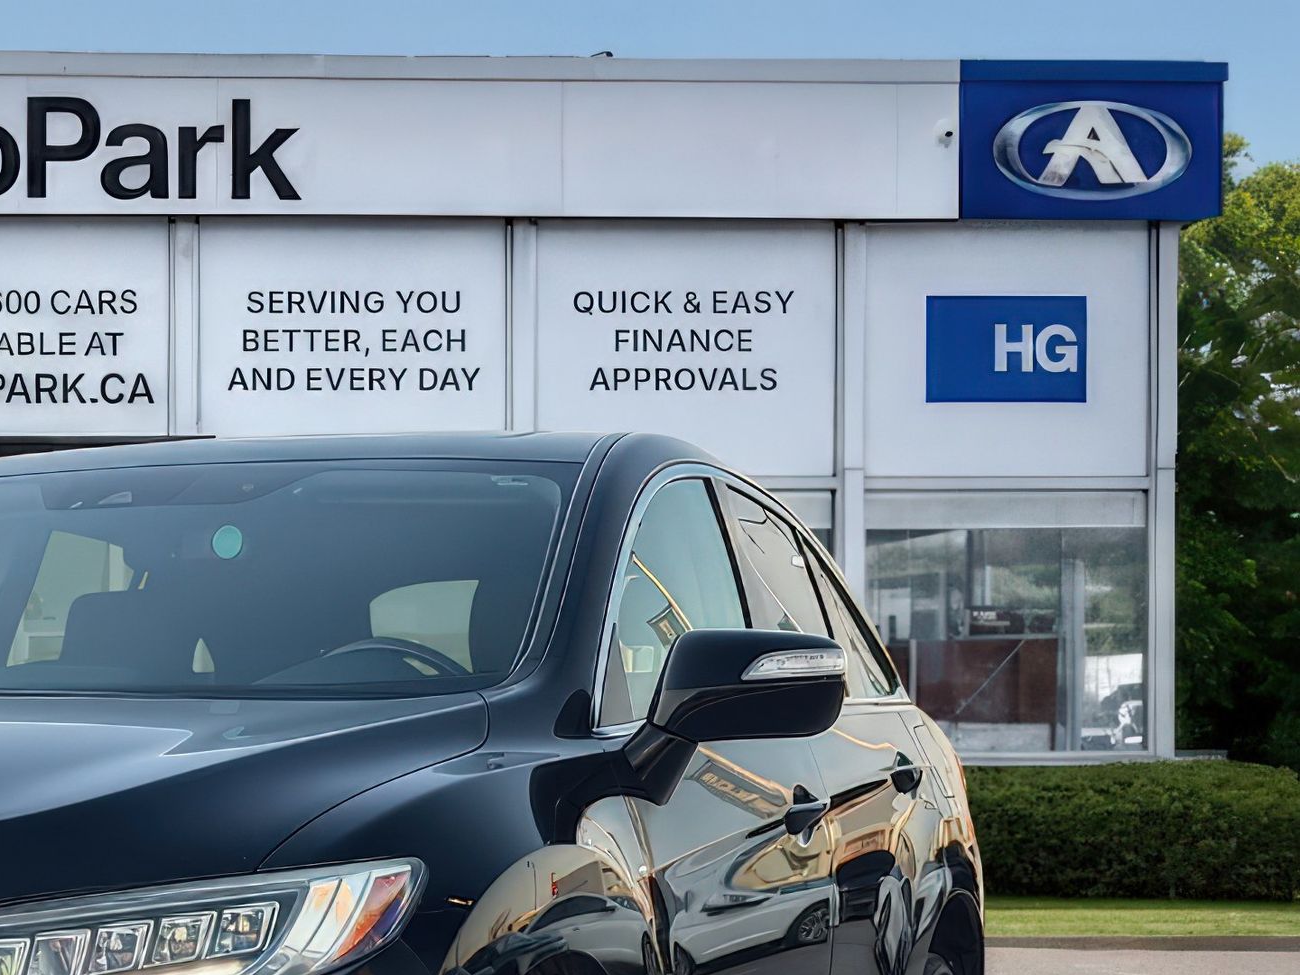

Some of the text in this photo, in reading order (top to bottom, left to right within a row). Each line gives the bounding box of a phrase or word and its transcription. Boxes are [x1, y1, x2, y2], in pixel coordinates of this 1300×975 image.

[50, 288, 138, 316] CARS
[246, 290, 461, 314] SERVING YOU
[573, 290, 795, 316] QUICK & EASY
[84, 331, 125, 357] AT
[242, 328, 466, 358] BETTER, EACH
[614, 328, 753, 353] FINANCE
[994, 323, 1078, 373] HG
[227, 367, 481, 392] AND EVERY DAY
[589, 367, 778, 392] APPROVALS
